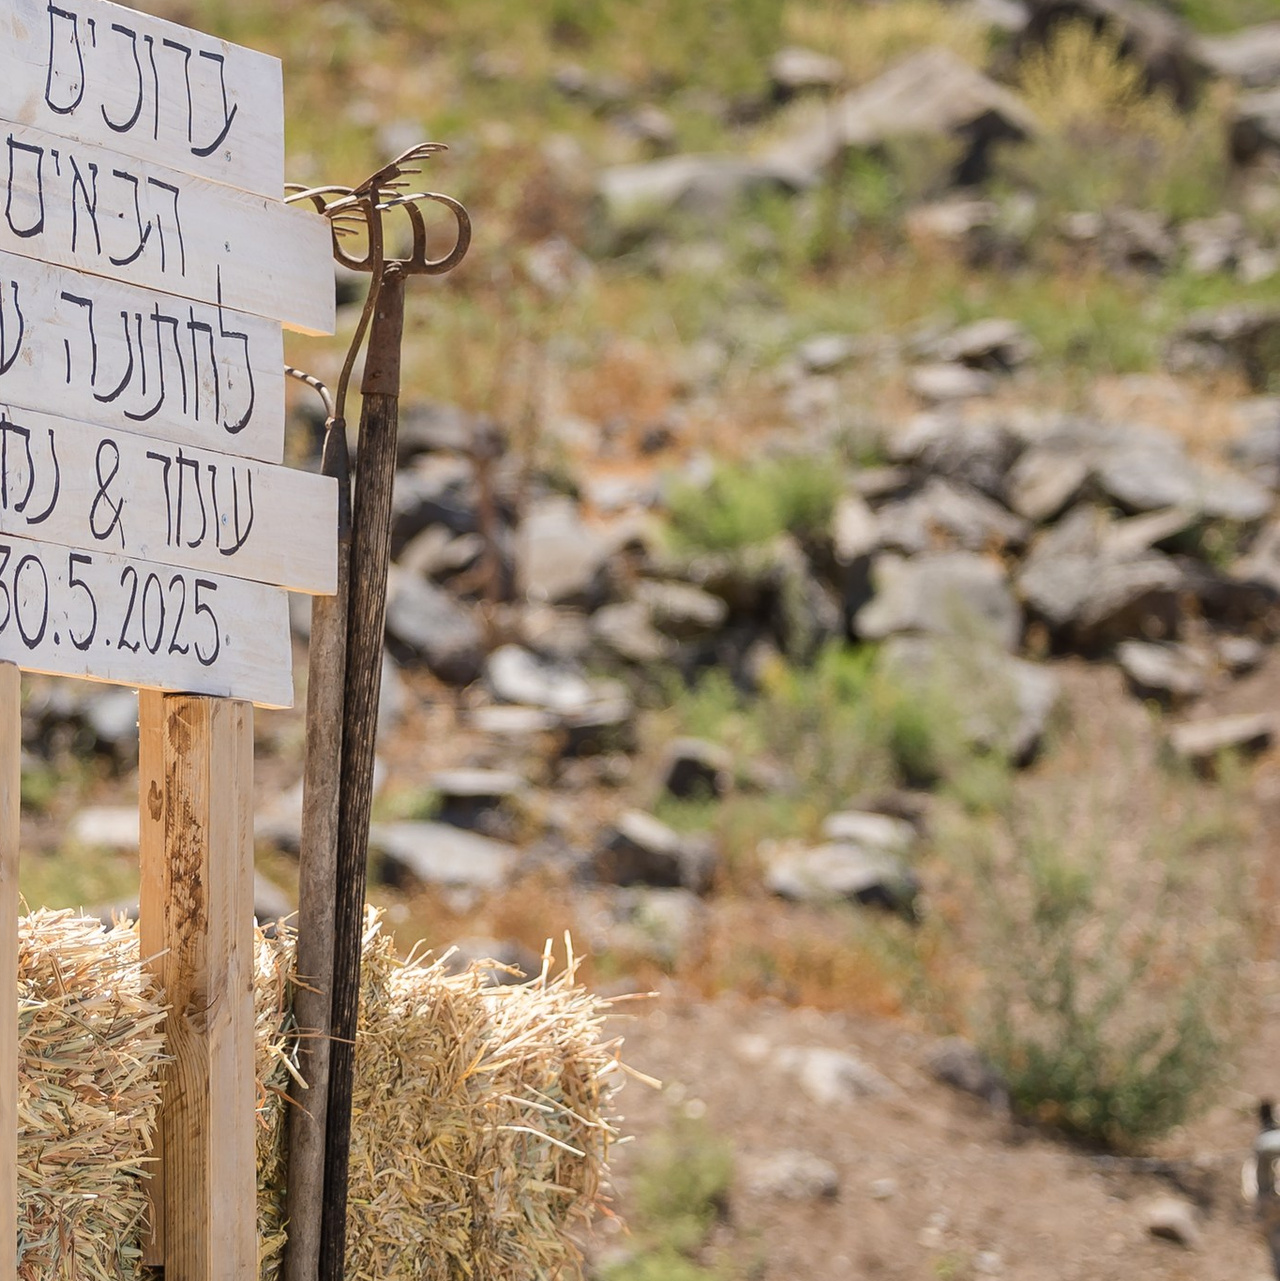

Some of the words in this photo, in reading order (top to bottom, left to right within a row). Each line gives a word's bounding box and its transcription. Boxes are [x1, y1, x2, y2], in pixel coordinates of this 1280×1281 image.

[5, 133, 186, 277] הבאים
[60, 264, 256, 435] לחתונה
[89, 438, 126, 550] &
[146, 446, 255, 556] עומר
